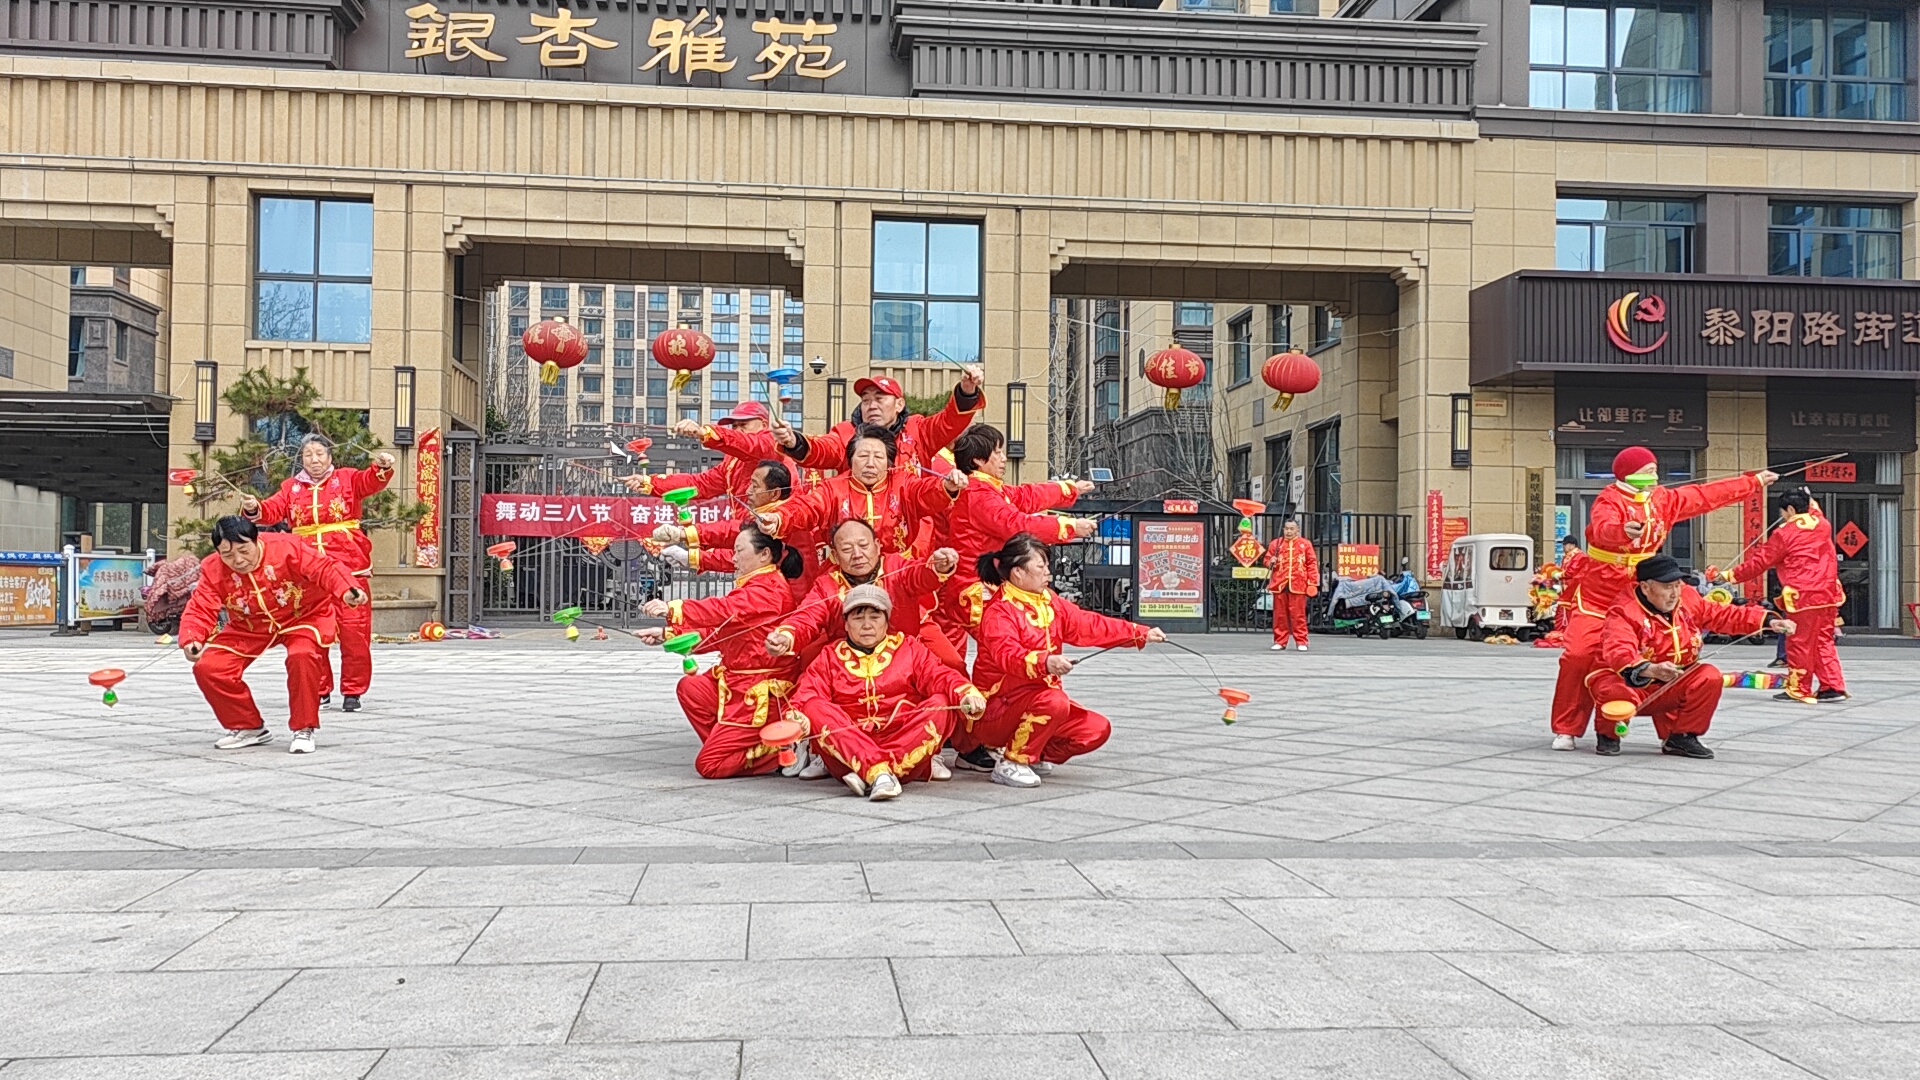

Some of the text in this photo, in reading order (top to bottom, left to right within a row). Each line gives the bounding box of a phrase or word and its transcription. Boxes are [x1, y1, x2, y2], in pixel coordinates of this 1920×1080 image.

[405, 2, 847, 84] 銀杏雅苑
[1579, 407, 1684, 424] 让邻里在一起
[495, 502, 612, 524] 舞动三八节
[1844, 530, 1858, 547] 福
[1238, 540, 1256, 558] 福
